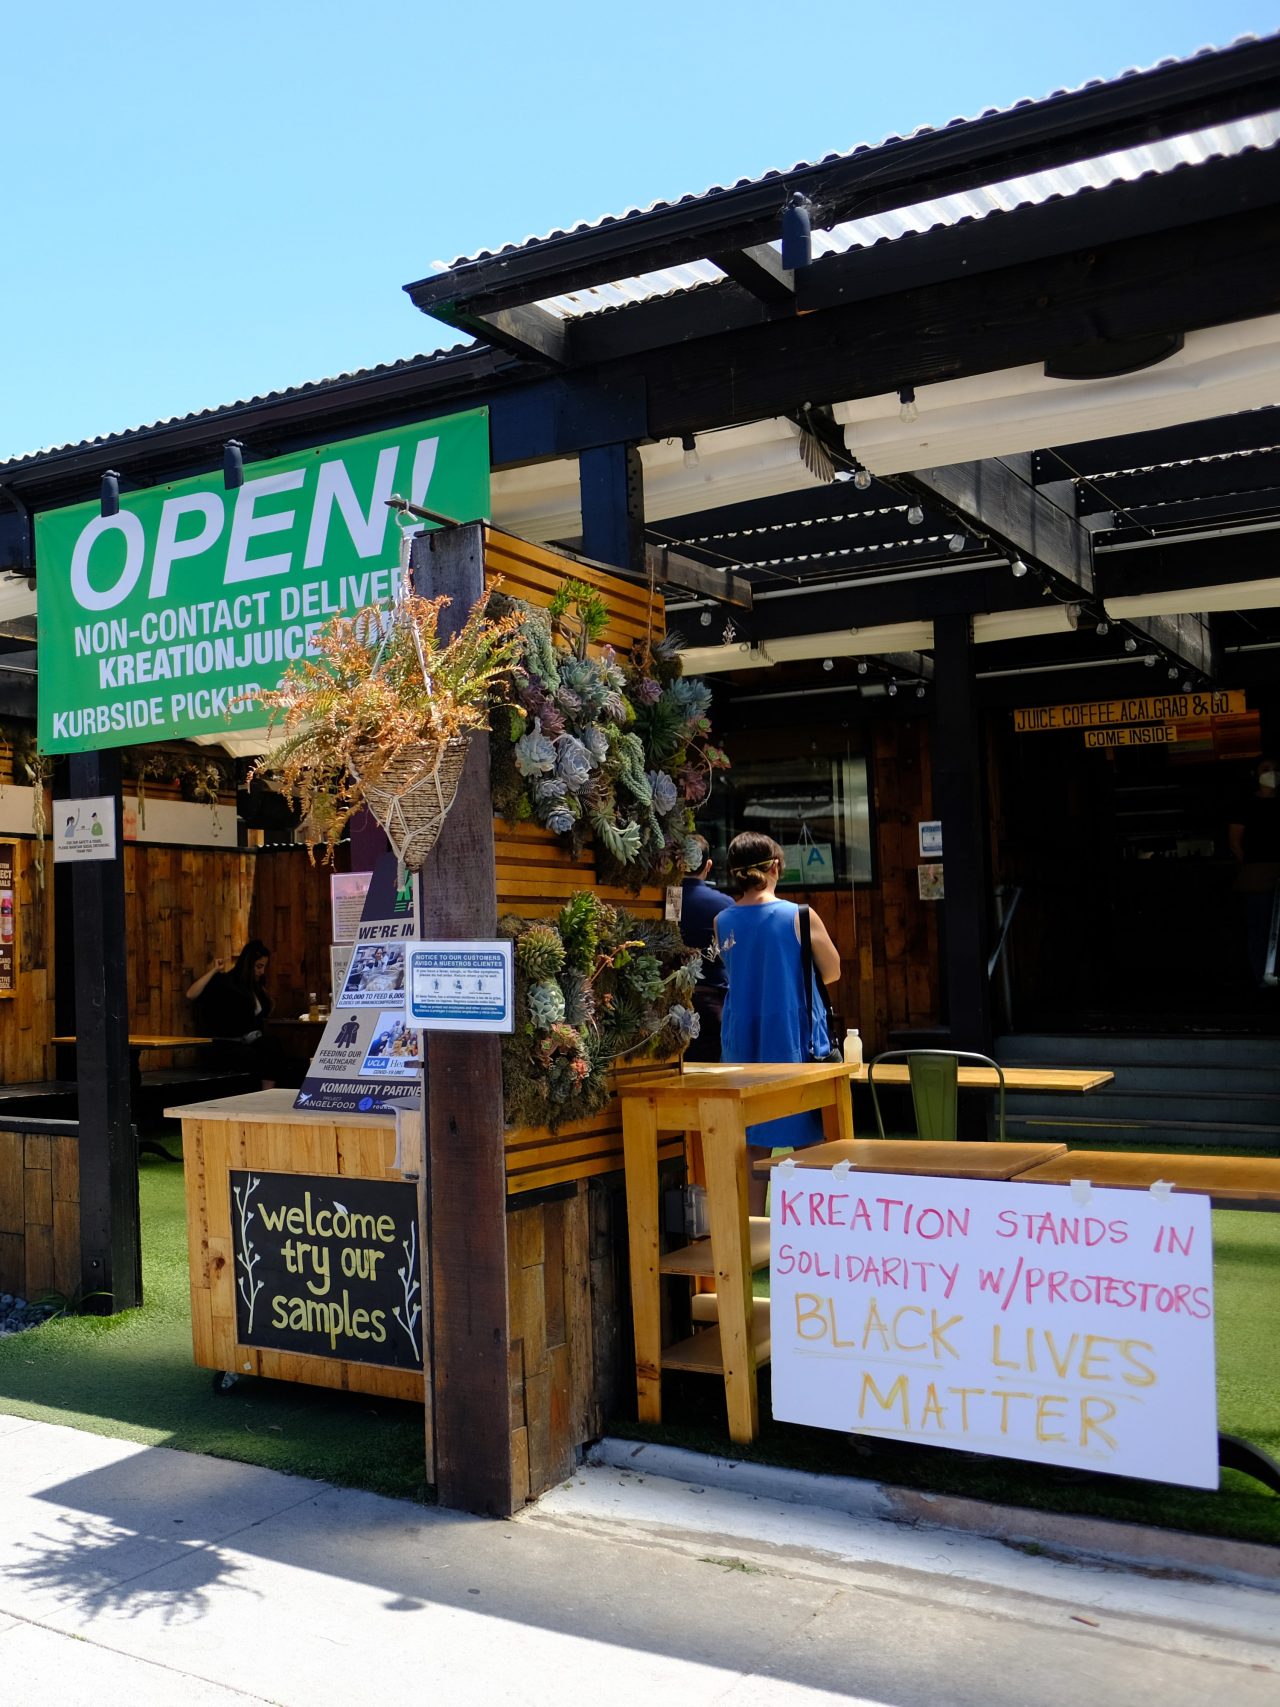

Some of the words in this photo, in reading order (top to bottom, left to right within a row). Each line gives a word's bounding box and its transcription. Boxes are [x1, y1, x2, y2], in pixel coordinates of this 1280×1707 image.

[70, 436, 440, 612] OPEN!
[74, 590, 271, 657] NON-CONTACT
[52, 697, 164, 739] KURBSIDE
[1192, 695, 1208, 716] &
[1087, 731, 1126, 747] COME
[1129, 727, 1175, 744] INSIDE
[807, 847, 826, 866] A
[359, 925, 399, 939] WE'RE
[303, 1100, 356, 1109] ANGELFOOD
[320, 1082, 382, 1095] KOMMUNITY
[382, 1085, 421, 1097] PARTNE
[257, 1191, 396, 1243] welcome
[780, 1189, 970, 1240] KREATION
[996, 1209, 1129, 1247] STANDS
[1154, 1224, 1195, 1257] IN
[280, 1238, 332, 1296] try
[341, 1246, 385, 1281] our
[776, 1244, 960, 1300] SOLIDARITY
[978, 1256, 1213, 1320] W/PROTESTORS
[271, 1289, 387, 1350] samples
[794, 1292, 965, 1361] BLACK
[992, 1324, 1158, 1388] LIVES
[857, 1371, 1119, 1452] MATTER
